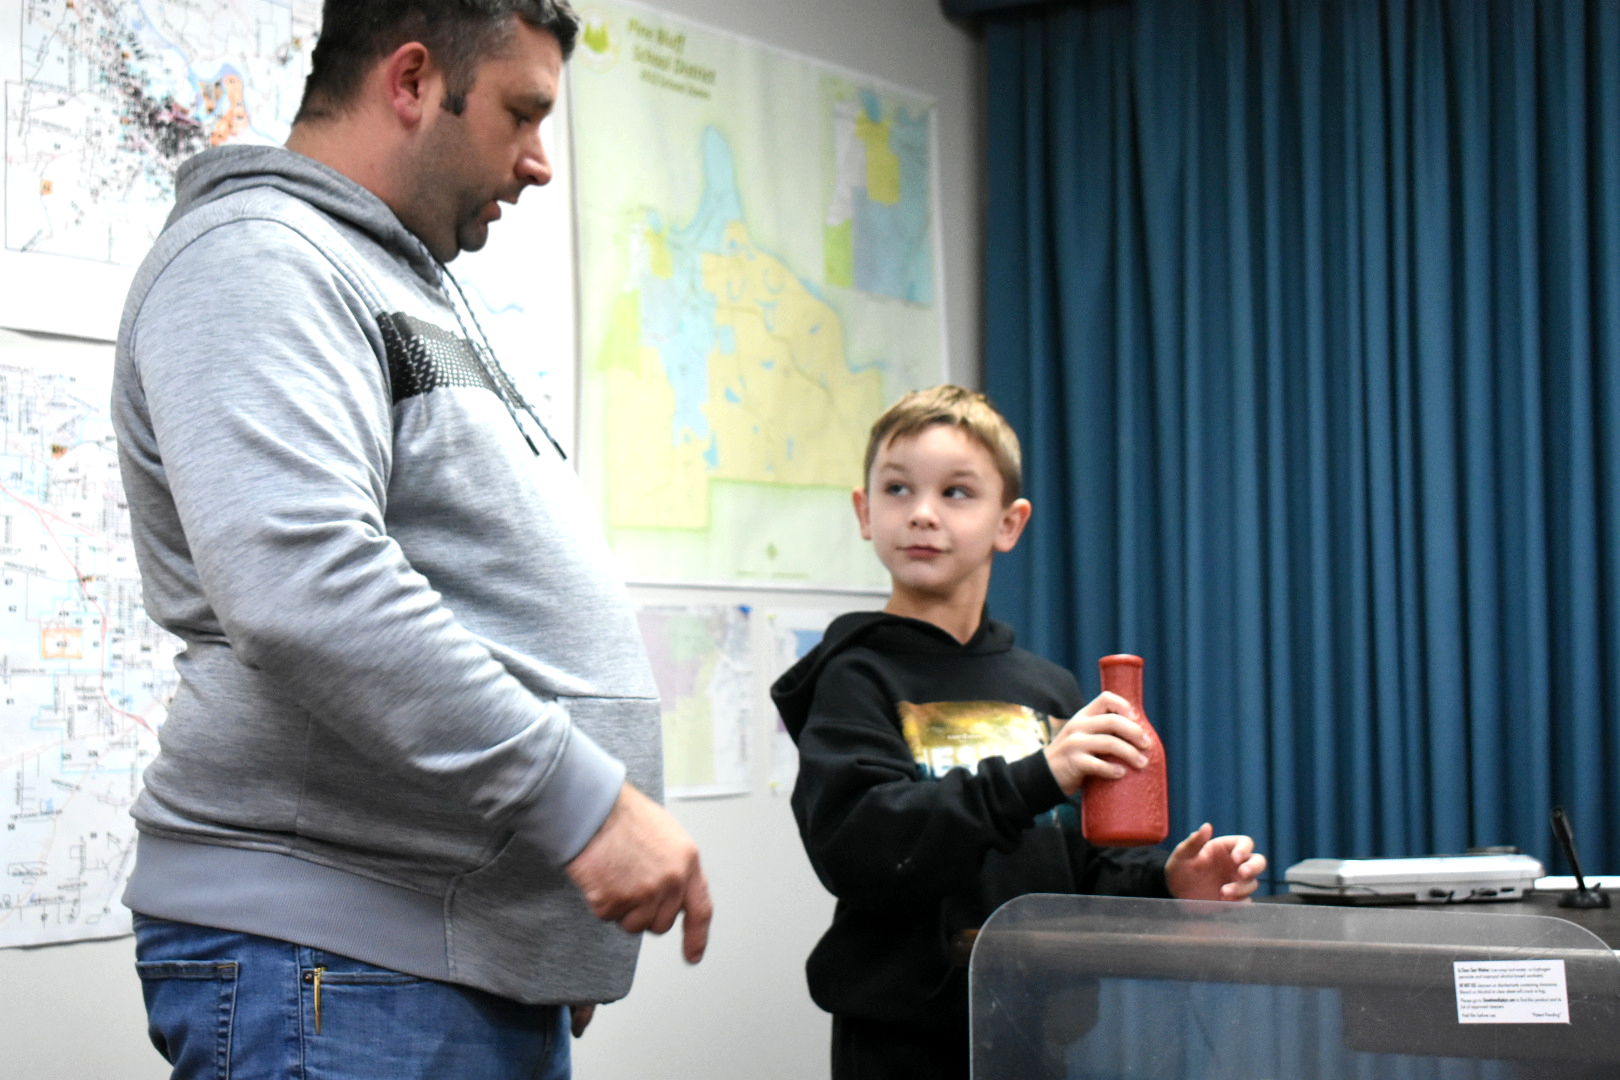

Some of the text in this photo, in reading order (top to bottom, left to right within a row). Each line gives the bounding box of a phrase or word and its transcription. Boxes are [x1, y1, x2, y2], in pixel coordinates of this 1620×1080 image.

[628, 18, 686, 56] Pine Bluff
[632, 45, 671, 71] School
